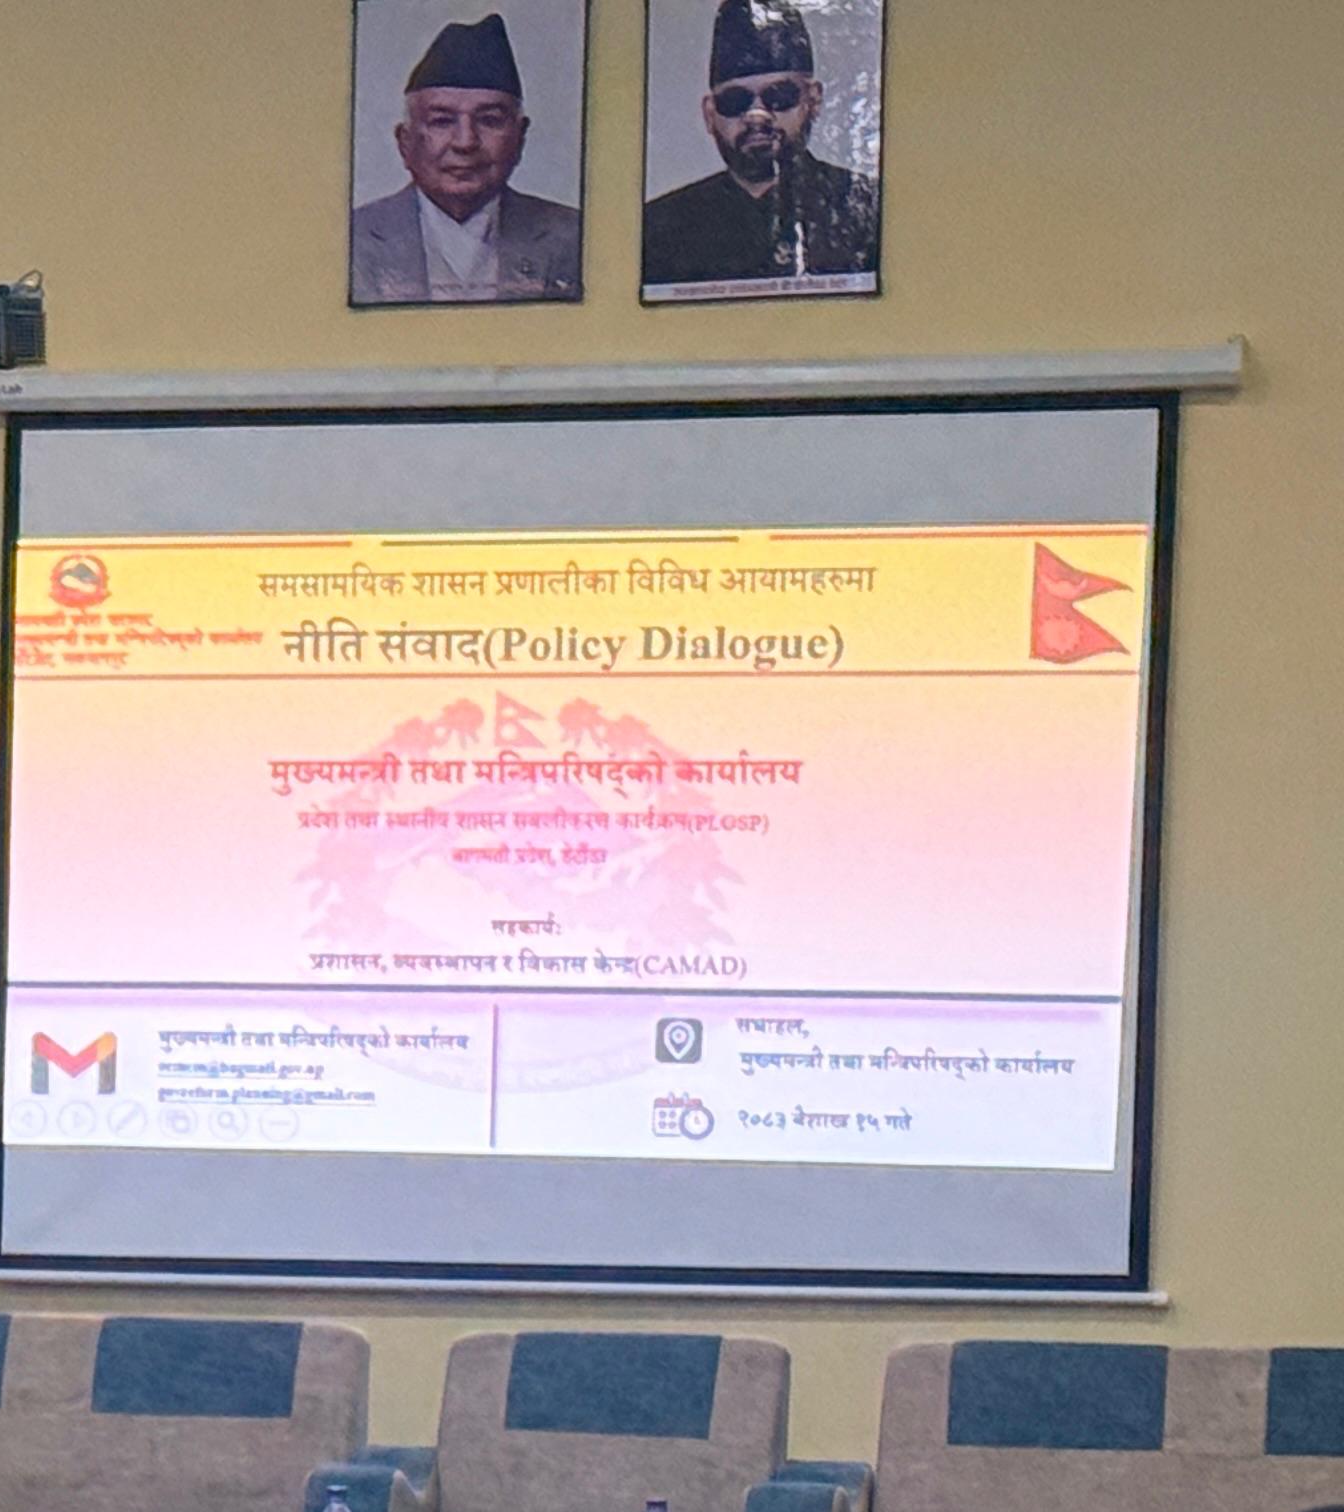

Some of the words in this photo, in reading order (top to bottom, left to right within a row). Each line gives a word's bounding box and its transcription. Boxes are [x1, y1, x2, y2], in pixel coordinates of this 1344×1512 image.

[258, 561, 405, 597] समसामयिक
[411, 571, 487, 597] शासन
[493, 560, 619, 596] प्रणालीका
[626, 558, 712, 594] विविध
[281, 616, 368, 663] नीति
[638, 624, 845, 671] Dialogue)
[267, 751, 402, 796] मुख्यमन्त्री
[408, 760, 466, 784] तथा
[674, 750, 803, 784] कार्यालय
